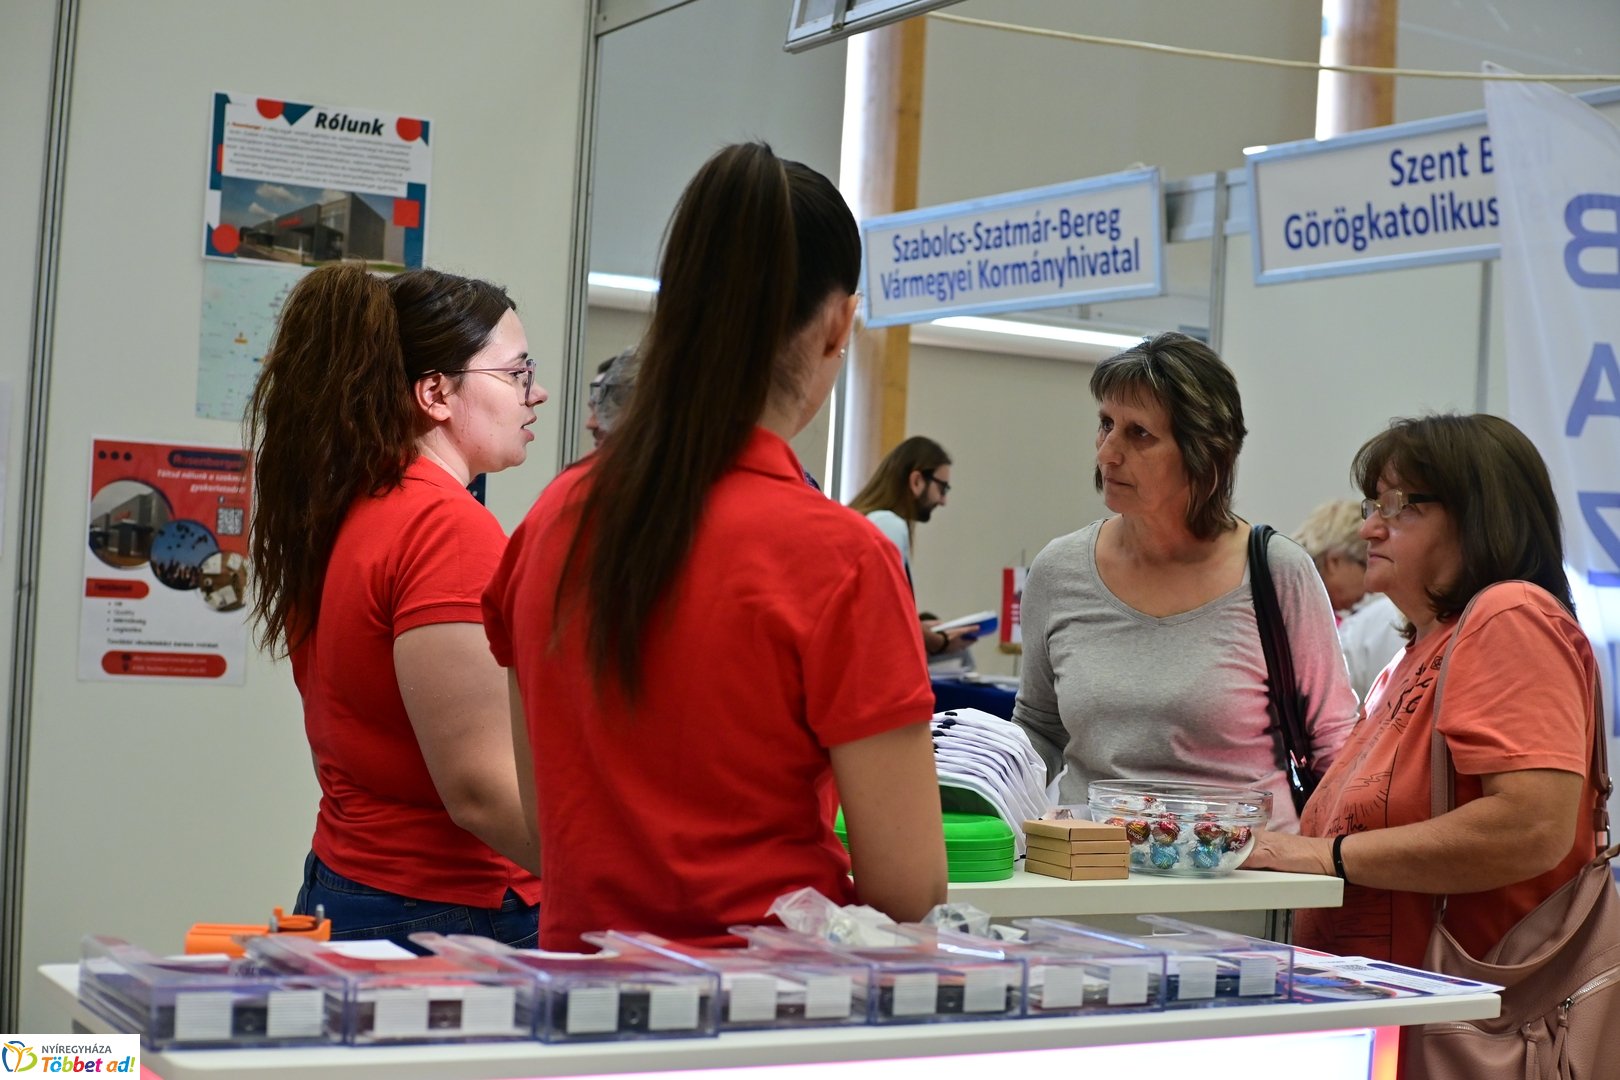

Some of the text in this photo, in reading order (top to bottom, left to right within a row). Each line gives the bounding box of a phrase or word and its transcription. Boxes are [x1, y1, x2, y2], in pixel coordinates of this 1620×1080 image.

[315, 112, 385, 136] Rólunk
[1390, 143, 1469, 187] Szent
[892, 207, 1122, 263] Szabolcs-Szatmár-Bereg
[1284, 191, 1499, 251] Görögkatolikus
[880, 237, 1140, 302] Vármegyei Kormányhivatal
